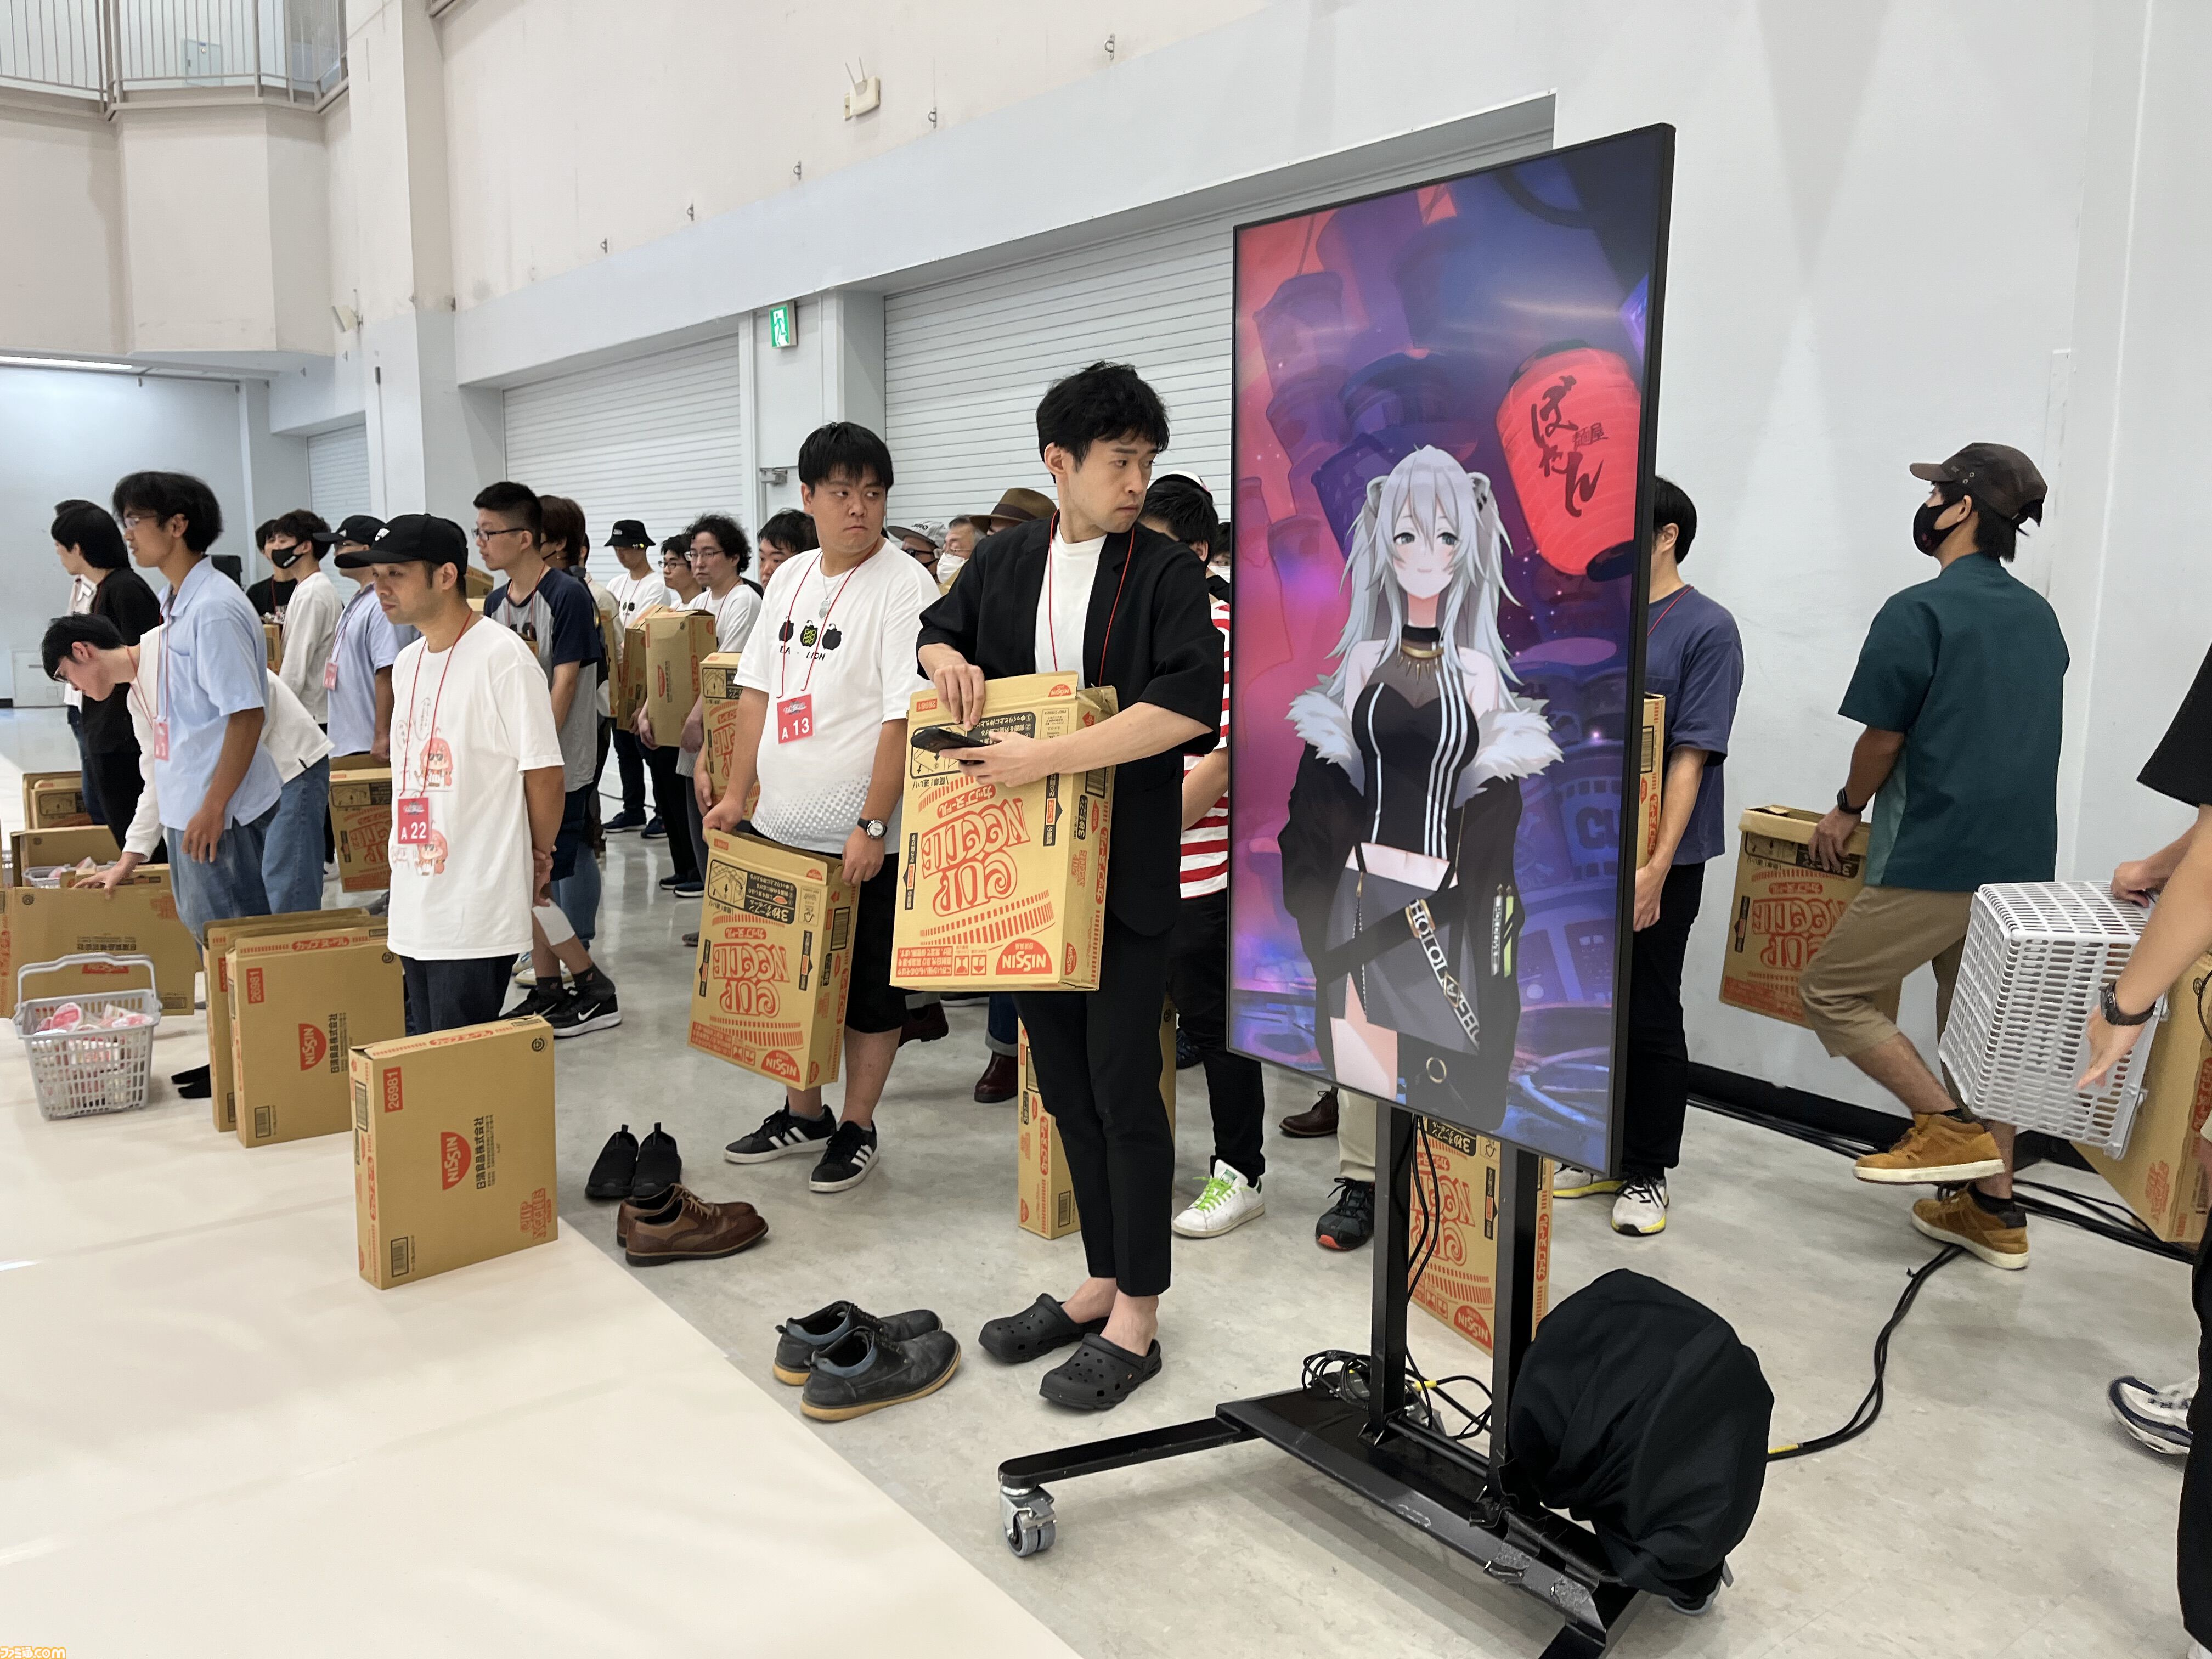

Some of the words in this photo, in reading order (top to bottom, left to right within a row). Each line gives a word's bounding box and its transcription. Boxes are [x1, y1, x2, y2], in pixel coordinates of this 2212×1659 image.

[1531, 375, 1604, 518] ぼたん
[781, 727, 788, 740] A
[793, 717, 810, 736] 13
[939, 787, 994, 815] カップヌードル
[400, 826, 408, 840] A
[410, 821, 427, 839] 22
[921, 798, 1031, 879] NOODLE
[932, 850, 1018, 917] CUP
[1097, 831, 1108, 900] カップヌードル
[712, 942, 790, 982] NOODLE
[1001, 950, 1047, 973] NISSIN
[719, 979, 781, 1018] CUP
[302, 1027, 318, 1065] NISSIN
[765, 1057, 798, 1078] NISSIN
[387, 1070, 400, 1109] 26981
[444, 1137, 460, 1182] NISSIN
[473, 1117, 486, 1190] 日清食品株式会社
[1538, 1217, 1548, 1277] カップヌードル
[1458, 1313, 1488, 1342] NISSIN
